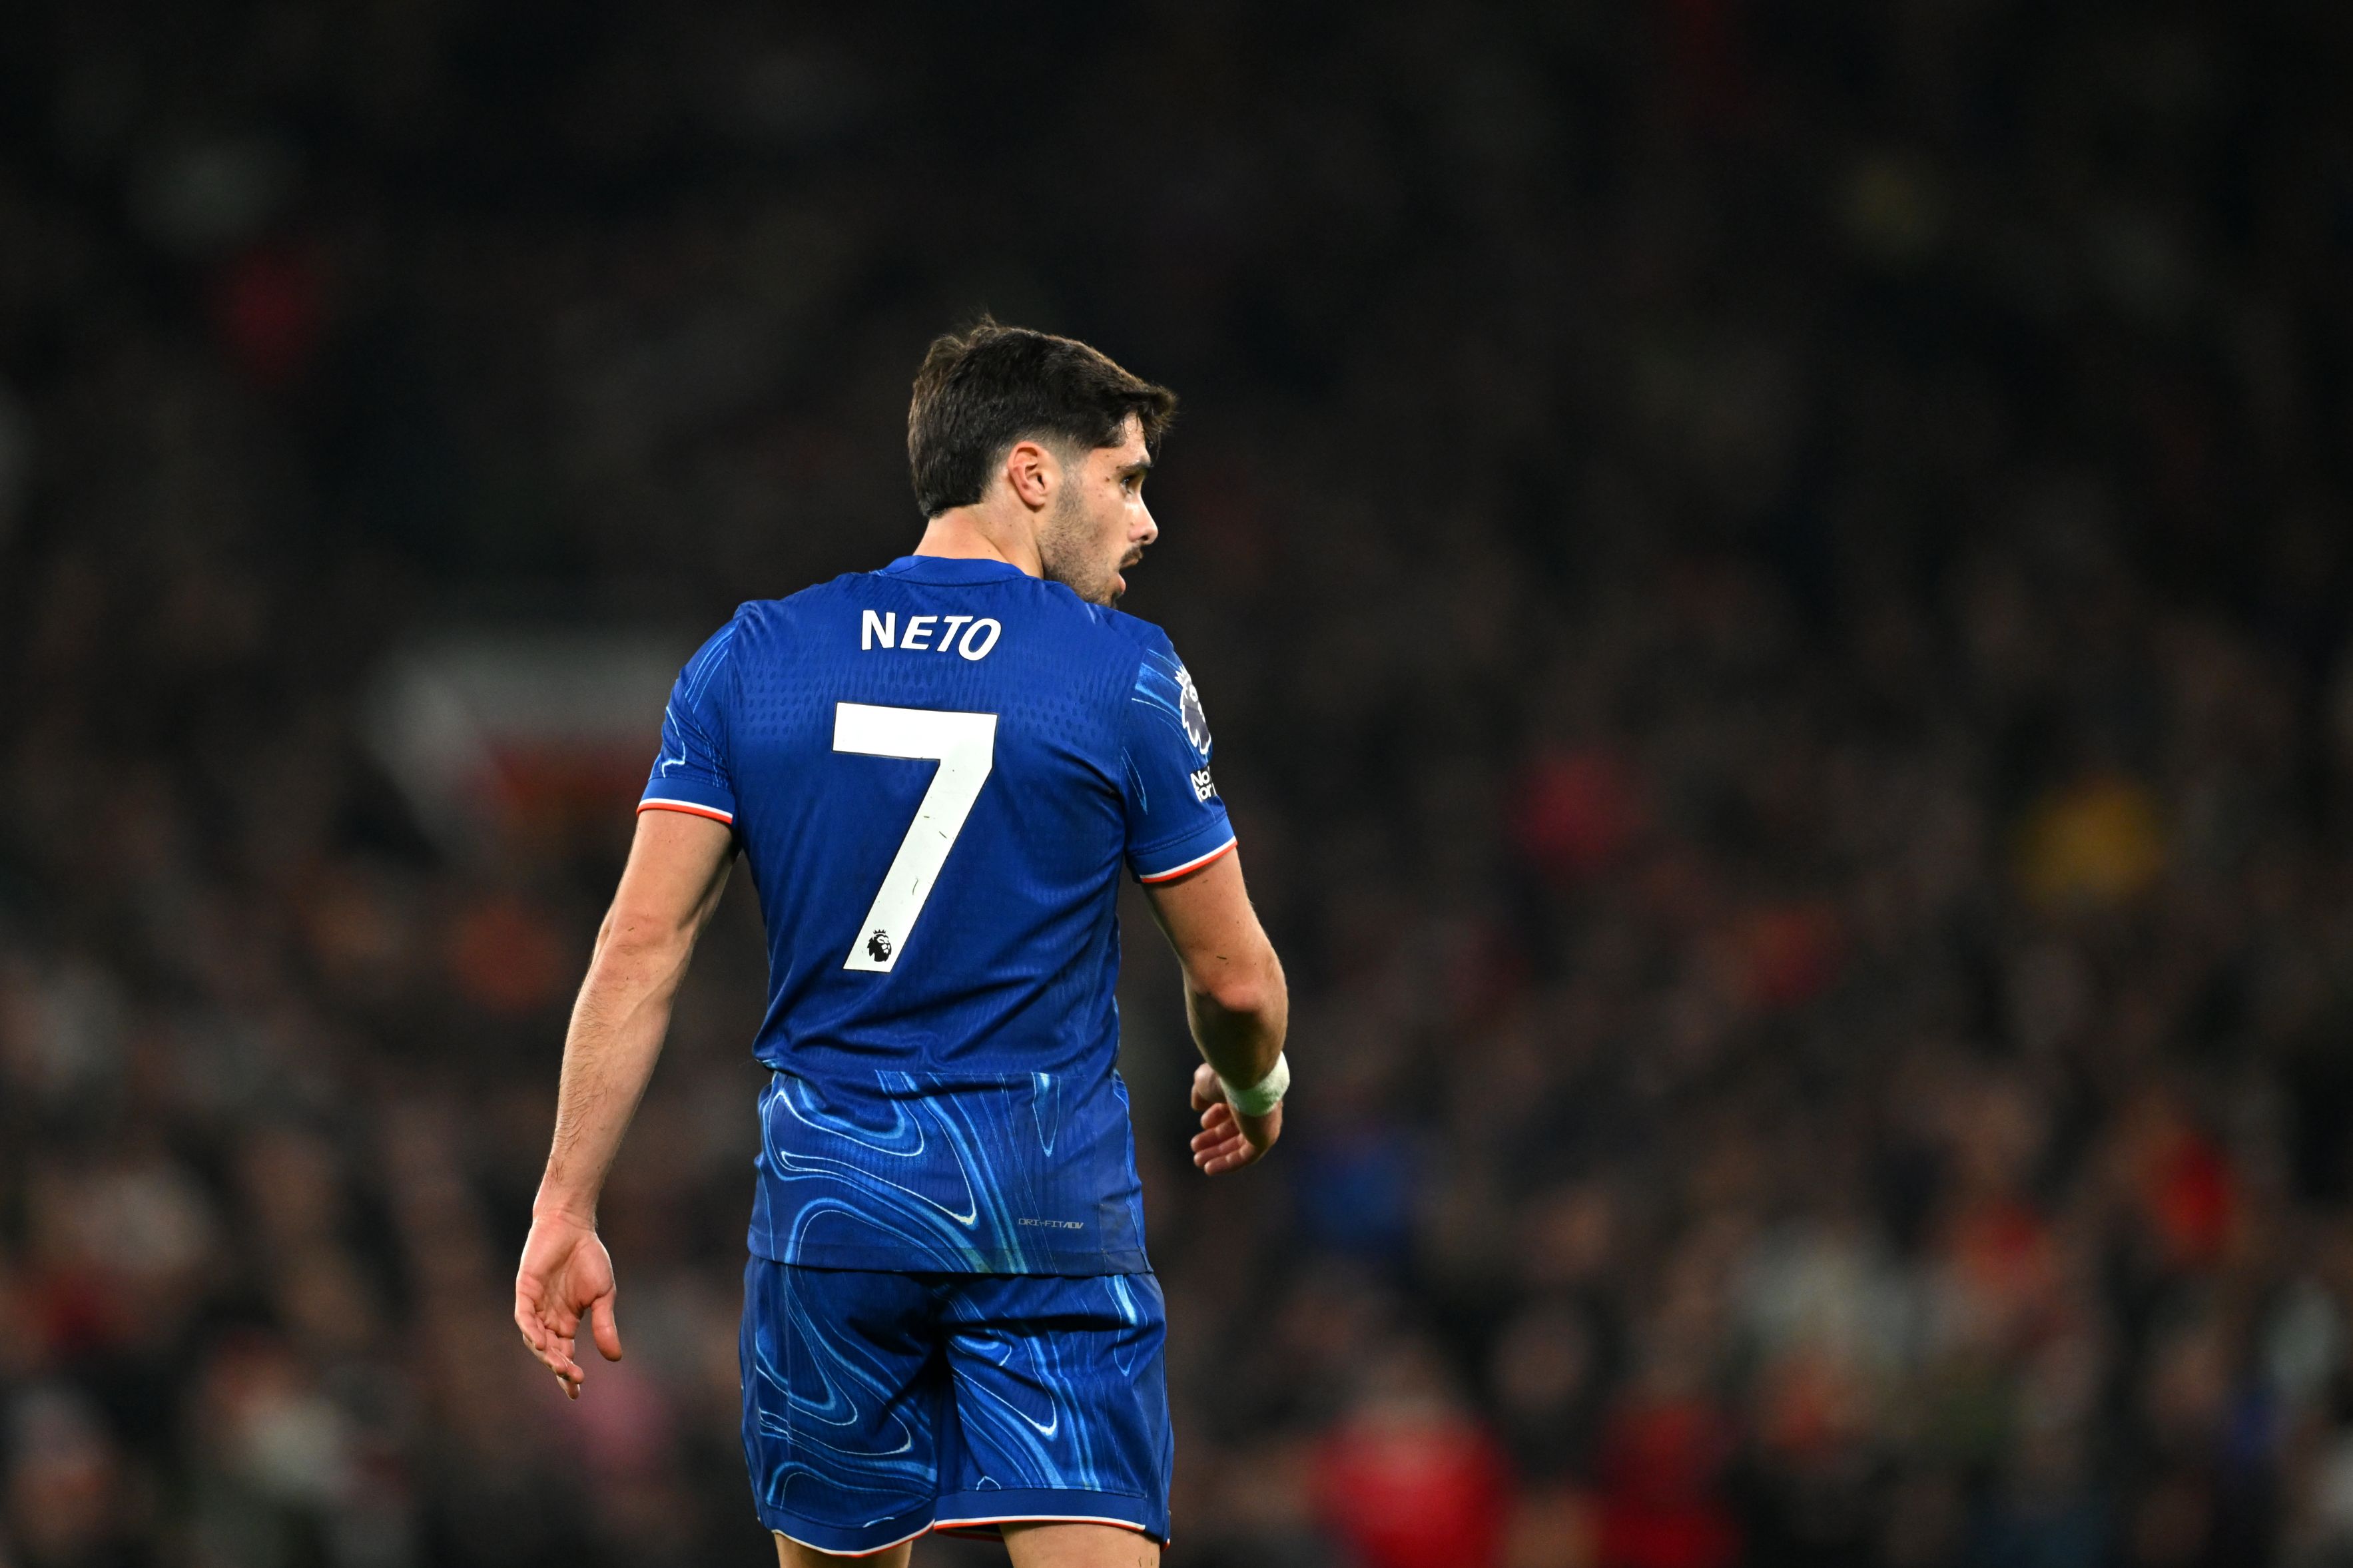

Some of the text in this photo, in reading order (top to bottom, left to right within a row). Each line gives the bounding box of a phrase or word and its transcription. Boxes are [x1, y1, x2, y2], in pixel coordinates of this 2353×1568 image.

[862, 610, 1002, 660] NETO
[1190, 770, 1210, 786] No
[833, 702, 998, 972] 7
